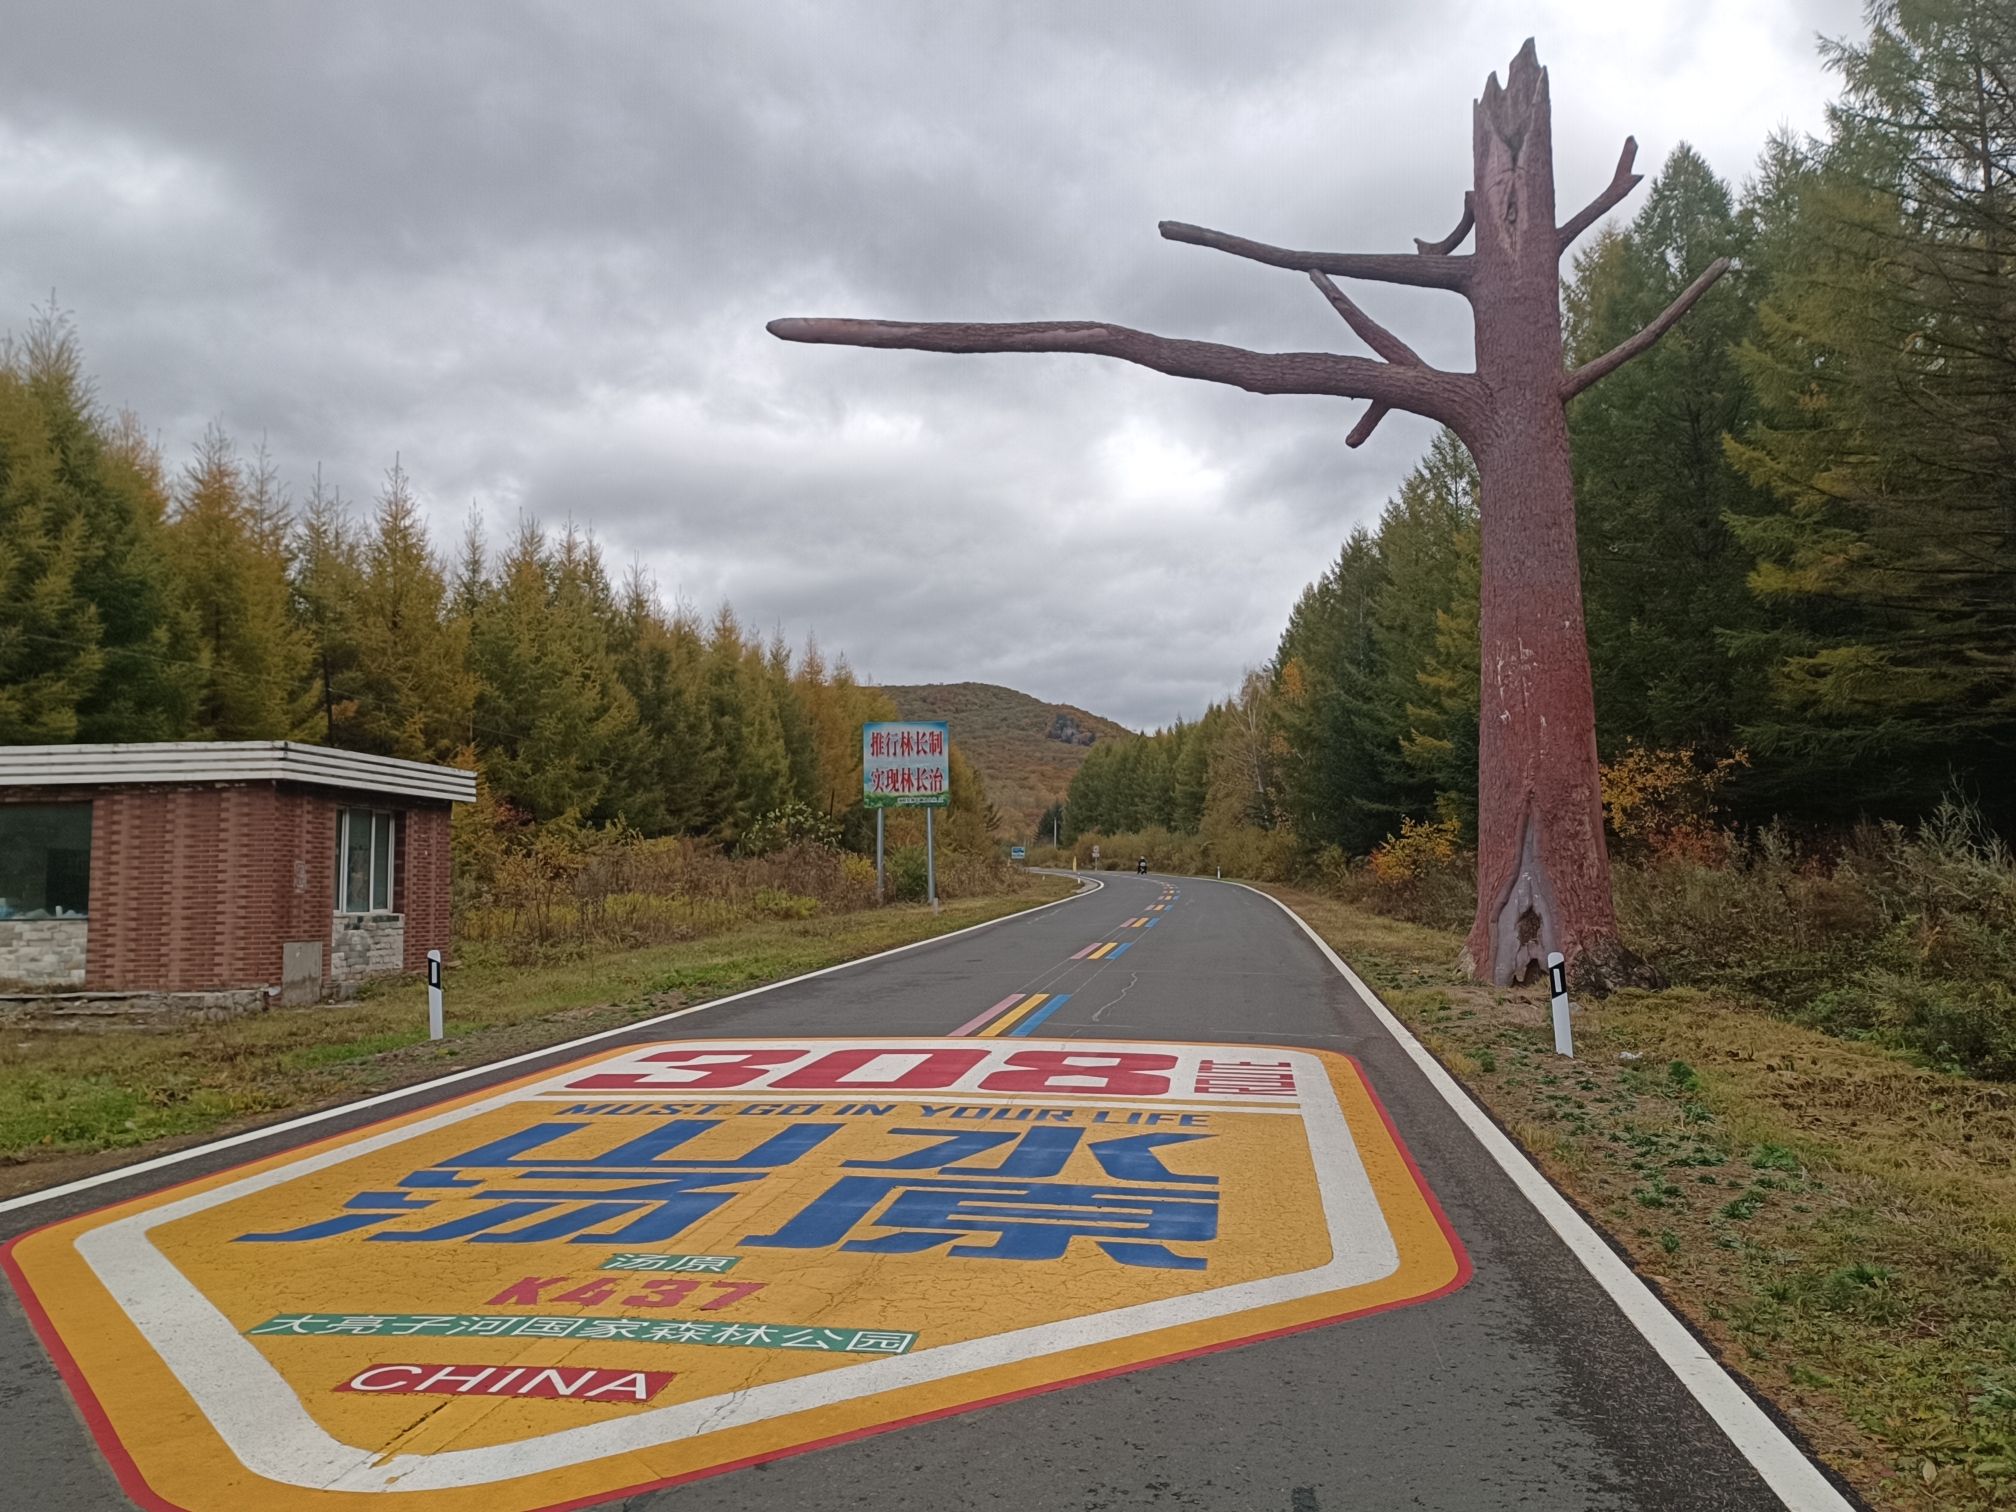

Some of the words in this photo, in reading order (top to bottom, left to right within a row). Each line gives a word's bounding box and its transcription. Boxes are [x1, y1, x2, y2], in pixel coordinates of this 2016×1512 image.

[870, 731, 943, 757] 推行林长制
[870, 767, 944, 793] 实现林长治
[564, 1049, 1179, 1096] 308
[1194, 1059, 1298, 1097] ROUTE
[554, 1103, 727, 1116] MUST
[739, 1103, 826, 1116] GO
[833, 1103, 897, 1116] IN
[919, 1104, 1073, 1123] YOUR
[1091, 1110, 1211, 1128] LIFE
[431, 1118, 1220, 1185] 山水
[228, 1171, 1220, 1270] 汤原
[603, 1253, 730, 1273] 汤原
[484, 1276, 768, 1311] K437
[271, 1314, 912, 1354] 大亮子河国家森林公园
[348, 1365, 650, 1400] CHINA
